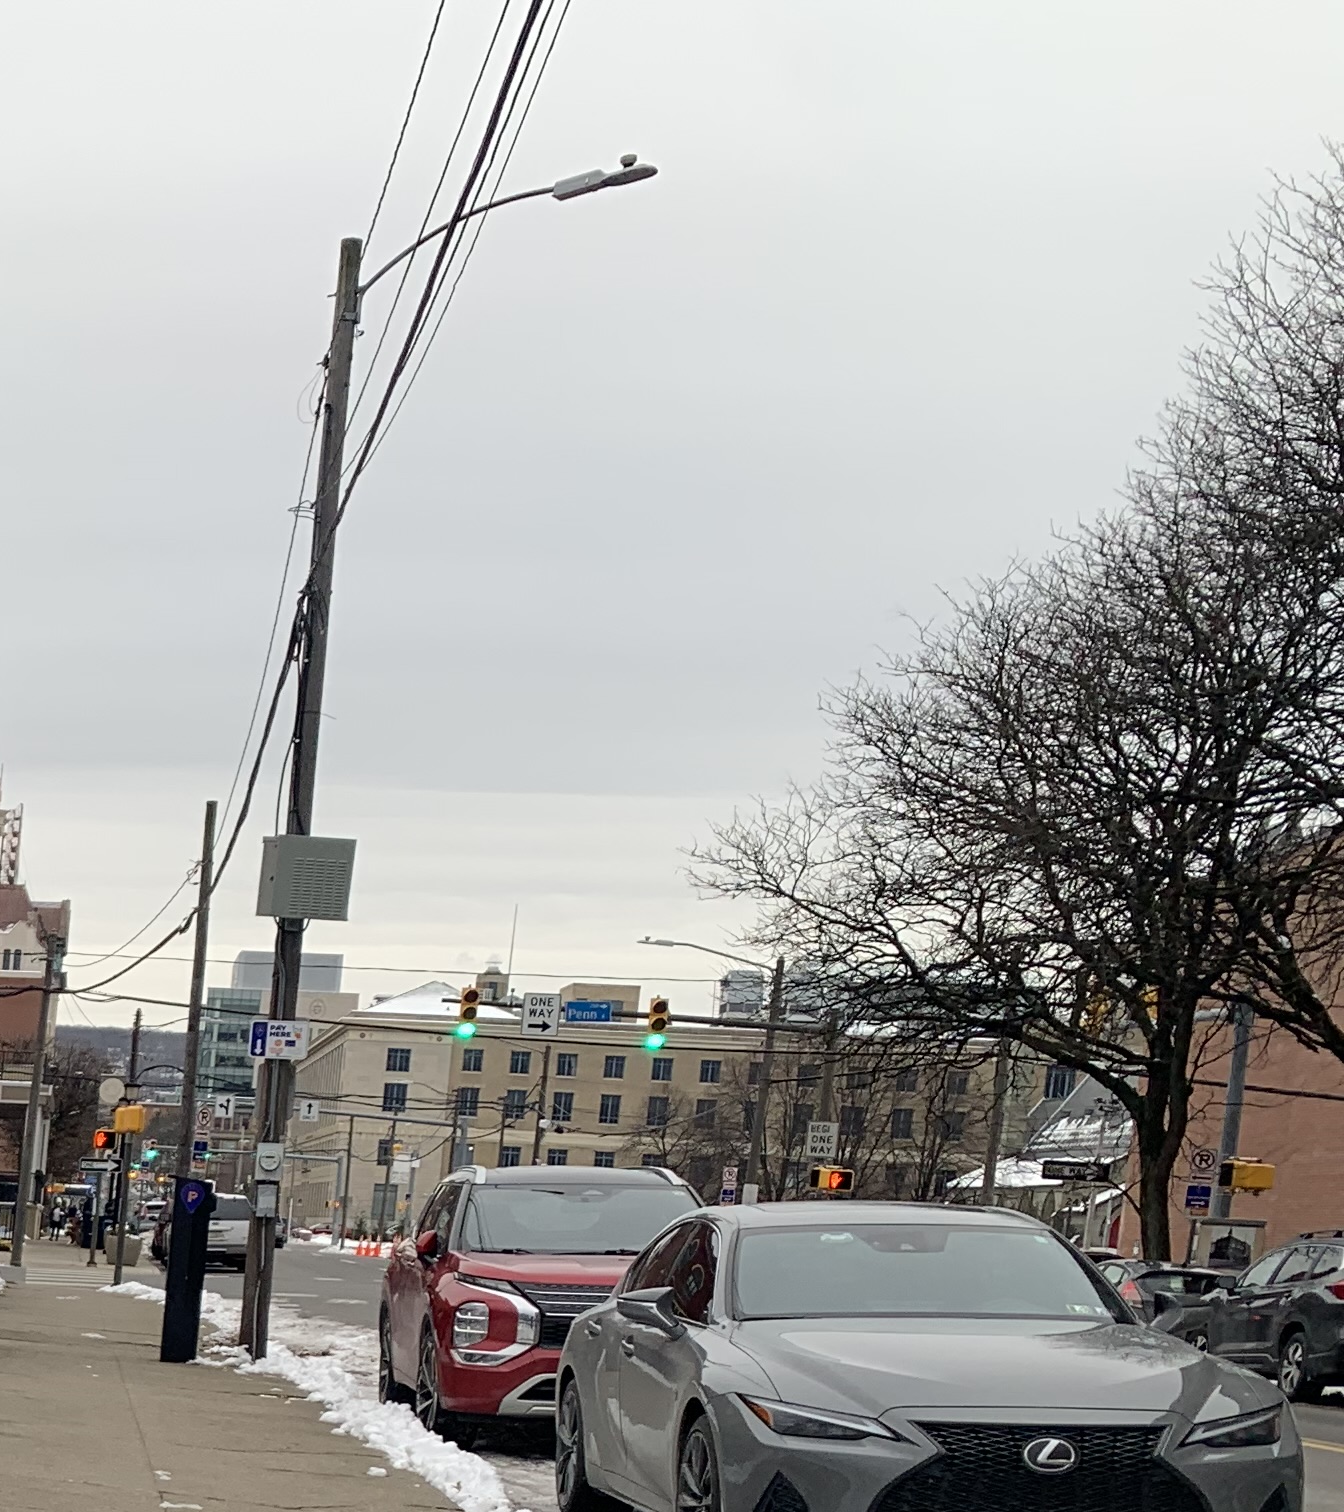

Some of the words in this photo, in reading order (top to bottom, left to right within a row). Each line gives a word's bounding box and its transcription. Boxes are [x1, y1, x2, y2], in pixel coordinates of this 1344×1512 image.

[530, 997, 554, 1007] ONE
[529, 1008, 554, 1018] WAY
[568, 1008, 597, 1020] Penn
[812, 1135, 833, 1144] ONE
[810, 1145, 833, 1154] WAY
[187, 1191, 198, 1202] P
